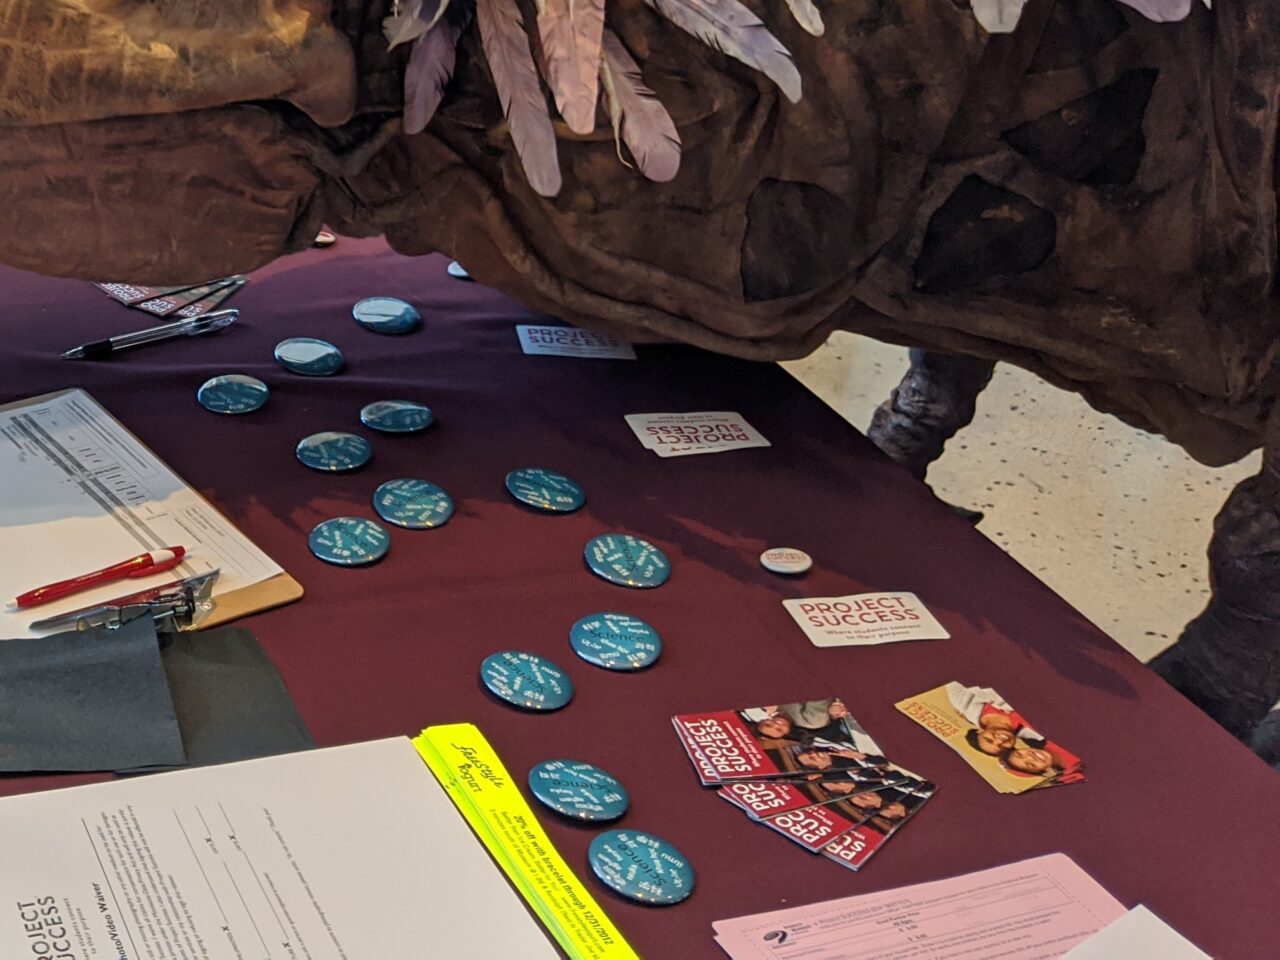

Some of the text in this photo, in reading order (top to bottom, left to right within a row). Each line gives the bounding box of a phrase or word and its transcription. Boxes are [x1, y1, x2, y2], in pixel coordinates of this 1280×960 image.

[646, 423, 744, 436] SUCCESS
[656, 433, 750, 445] PROJECT
[799, 596, 907, 615] PROJECT
[808, 609, 920, 628] SUCCESS
[590, 630, 645, 642] Science
[684, 720, 736, 775] PROJECT
[705, 718, 752, 772] SUCCESS
[513, 813, 527, 829] 20%
[524, 829, 536, 841] off
[531, 839, 546, 857] with
[542, 855, 566, 885] bracelet
[563, 883, 585, 911] through
[583, 909, 612, 947] 12/31/2012
[618, 843, 667, 887] Science
[17, 900, 54, 960] ROJECT
[35, 894, 76, 960] UCCESS
[88, 882, 129, 960] hoto/Video Waiver
